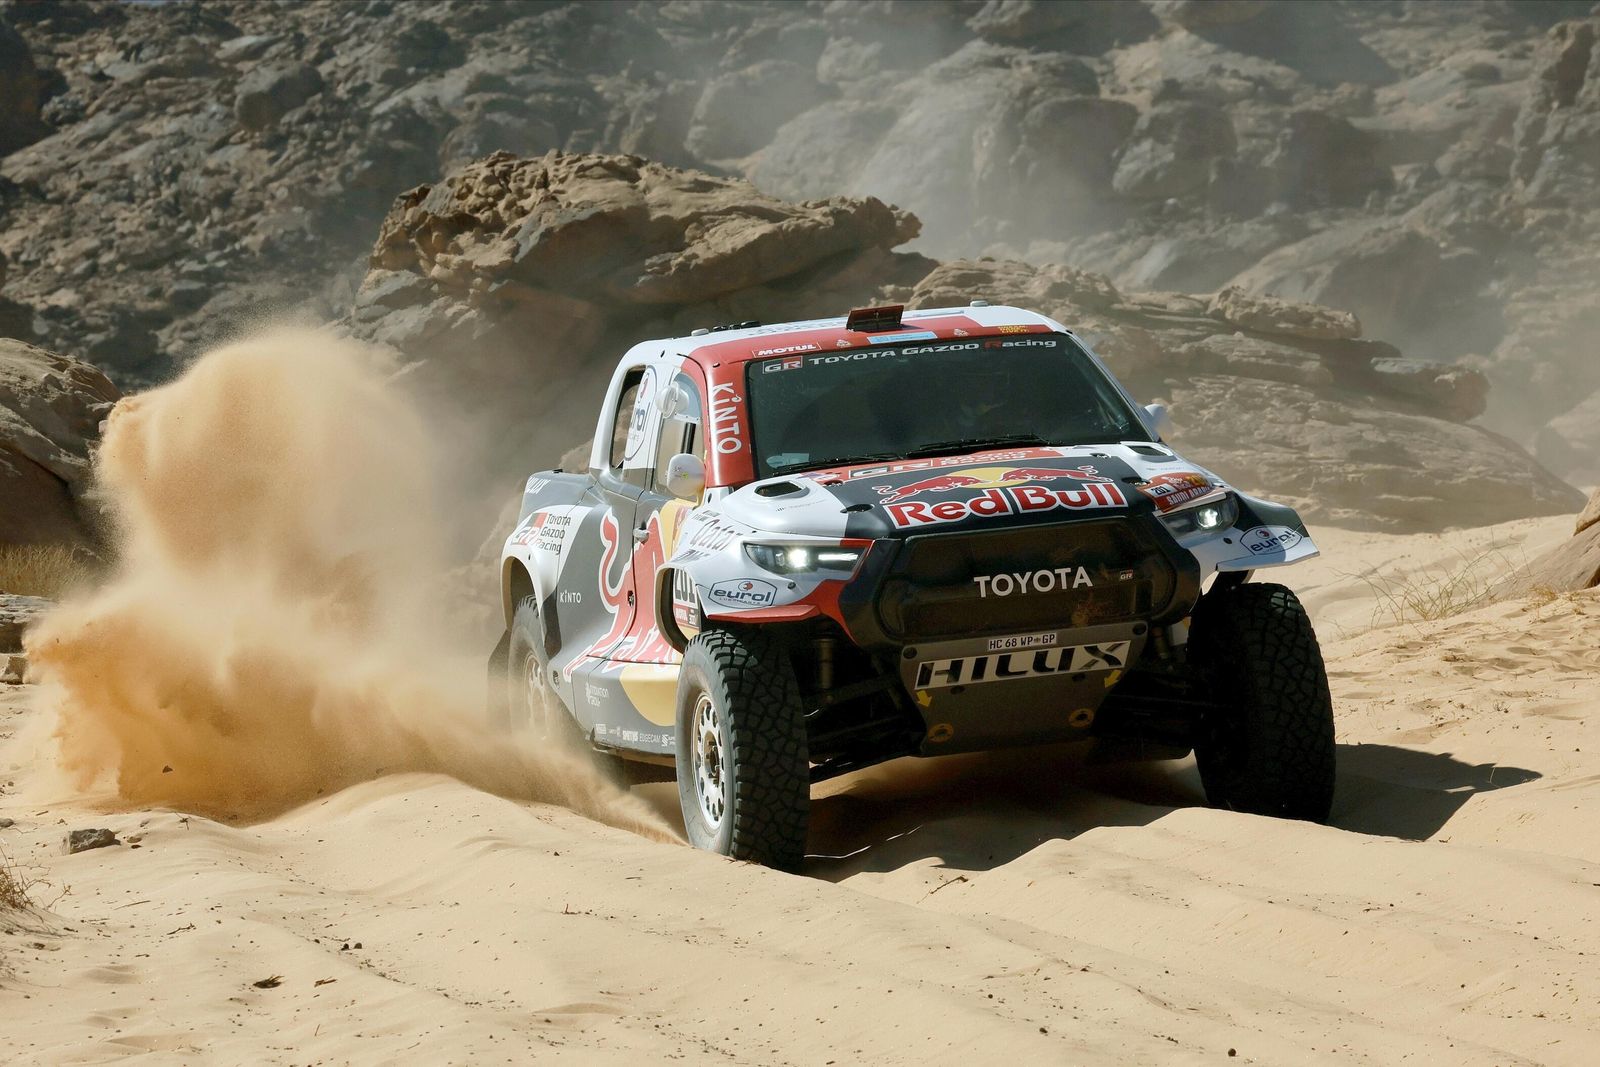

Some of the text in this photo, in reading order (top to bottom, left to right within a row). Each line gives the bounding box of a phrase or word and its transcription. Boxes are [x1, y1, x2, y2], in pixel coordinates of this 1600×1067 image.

[758, 344, 816, 356] MOTUL
[764, 339, 1057, 373] GR TOYOTA GAZOO Racing
[713, 382, 742, 454] KINTO
[1150, 486, 1170, 496] 201
[1166, 490, 1190, 505] SAUDI
[884, 482, 1128, 529] Red Bull
[546, 513, 572, 527] TOYOTA
[540, 526, 566, 540] GAZOO
[1250, 530, 1295, 552] eurol
[535, 538, 562, 556] Racing
[973, 566, 1093, 598] TOYOTA
[560, 590, 581, 603] KINTO
[713, 588, 772, 604] eurol
[990, 634, 1056, 650] HC 68 WP GP
[916, 642, 1126, 687] HILUX
